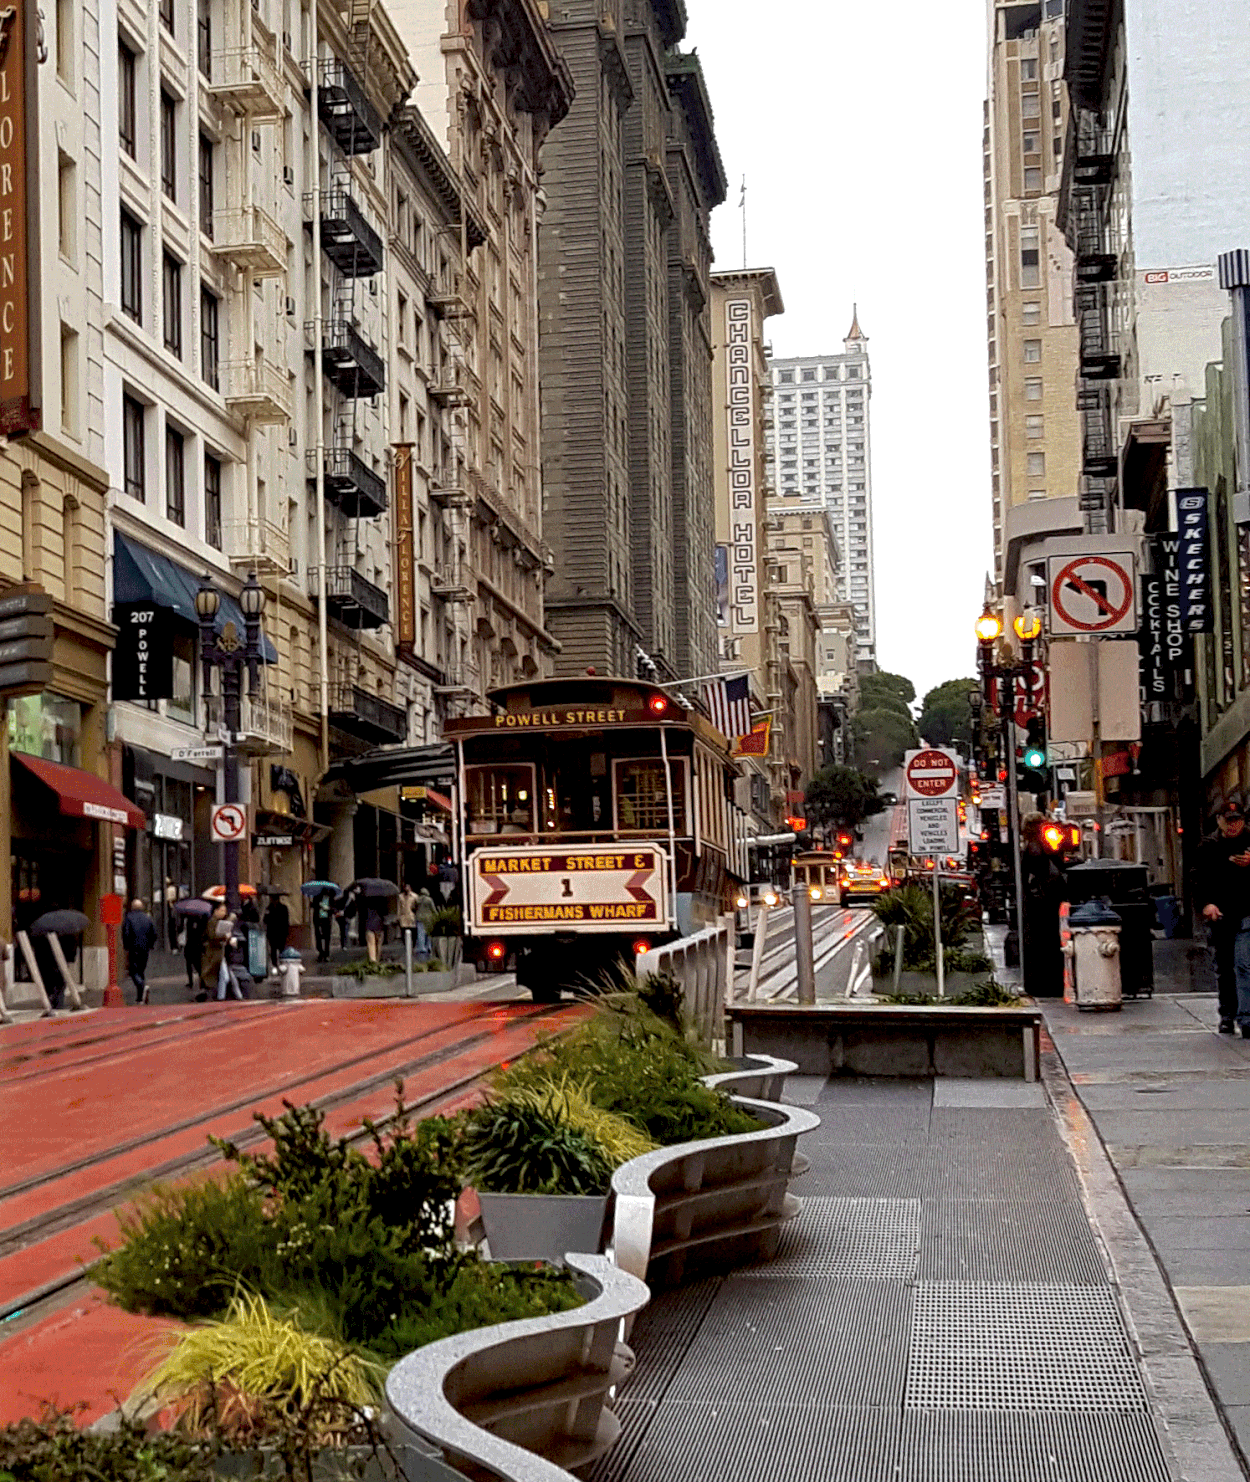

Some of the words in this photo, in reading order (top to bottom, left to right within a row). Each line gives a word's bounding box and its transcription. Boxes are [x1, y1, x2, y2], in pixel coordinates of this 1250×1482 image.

[727, 302, 753, 510] CHANCELLOR
[733, 523, 756, 625] HOTEL
[1162, 540, 1181, 597] WINE
[1183, 512, 1206, 630] SKECHERS
[130, 611, 155, 624] 207
[1166, 604, 1184, 661] SHOP
[136, 628, 150, 696] POWELL
[495, 711, 561, 727] POWELL
[566, 709, 626, 724] STREET
[913, 759, 927, 768] DO
[930, 758, 949, 767] NOT
[917, 779, 946, 788] ENTER
[484, 857, 552, 873] MARKET
[566, 855, 626, 871] STREET
[560, 878, 574, 898] 1
[488, 905, 585, 922] FISHERMANS
[589, 904, 648, 920] WHARF
